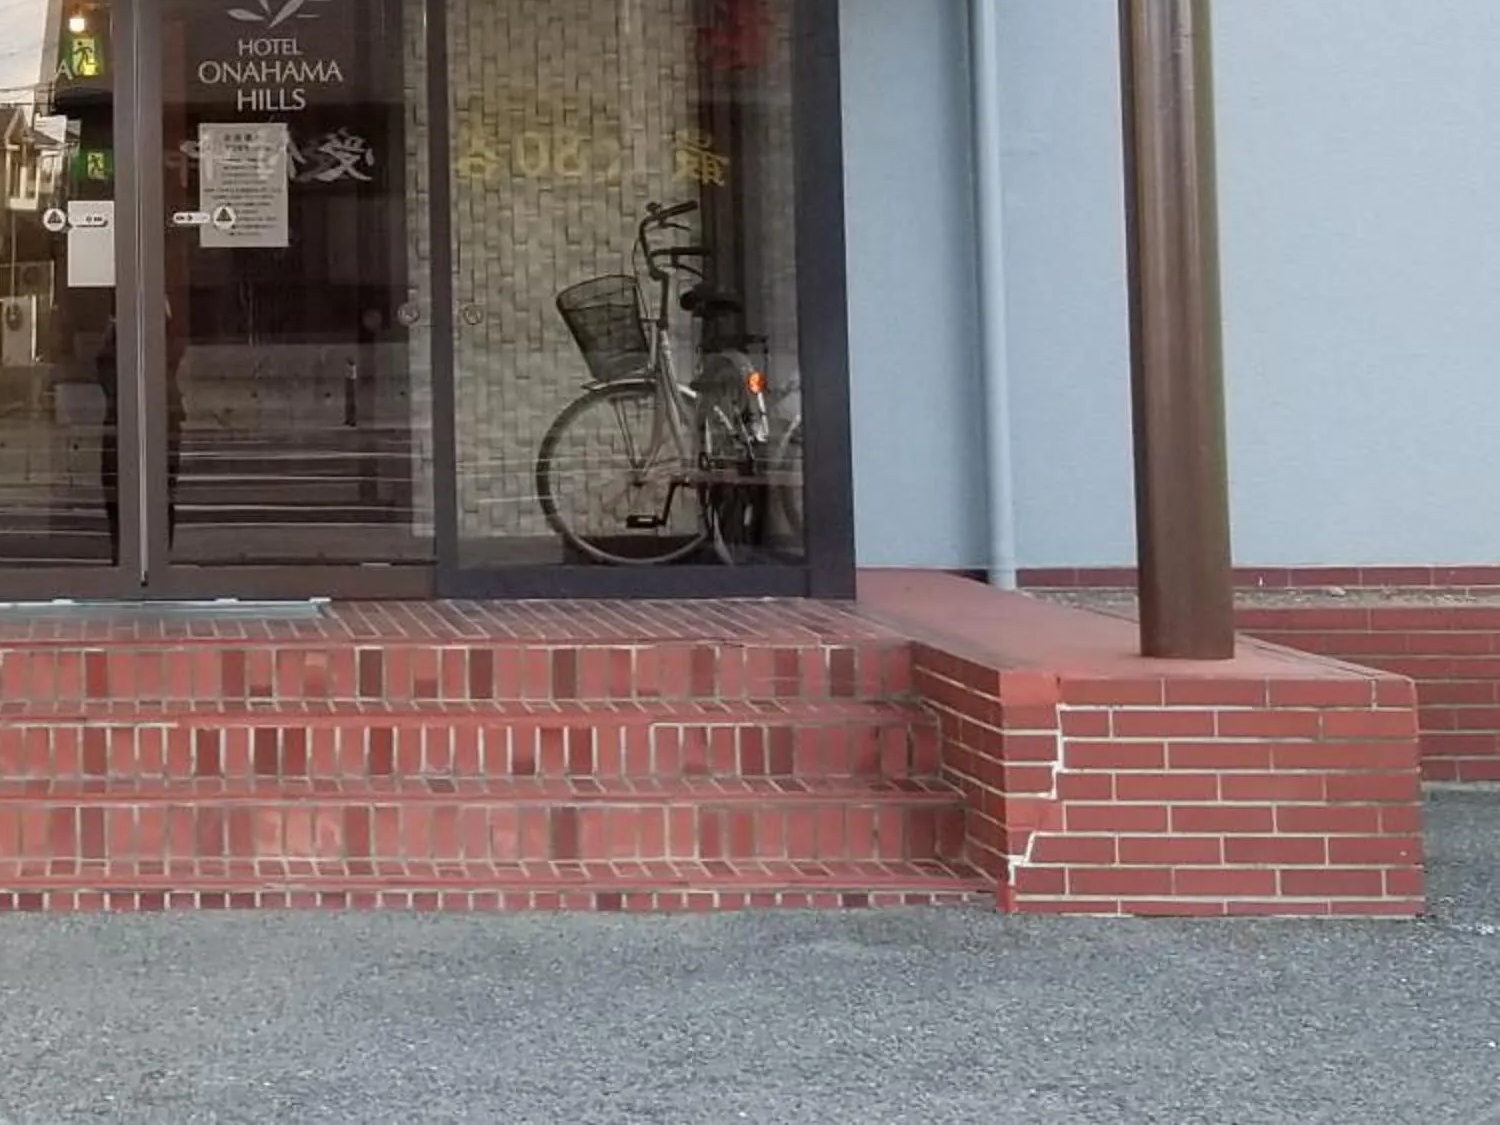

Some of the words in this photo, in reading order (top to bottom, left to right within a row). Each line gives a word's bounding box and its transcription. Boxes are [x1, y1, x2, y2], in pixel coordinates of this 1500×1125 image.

[238, 38, 302, 56] HOTEL
[198, 60, 343, 83] ONAHAMA
[237, 88, 306, 111] HILLS
